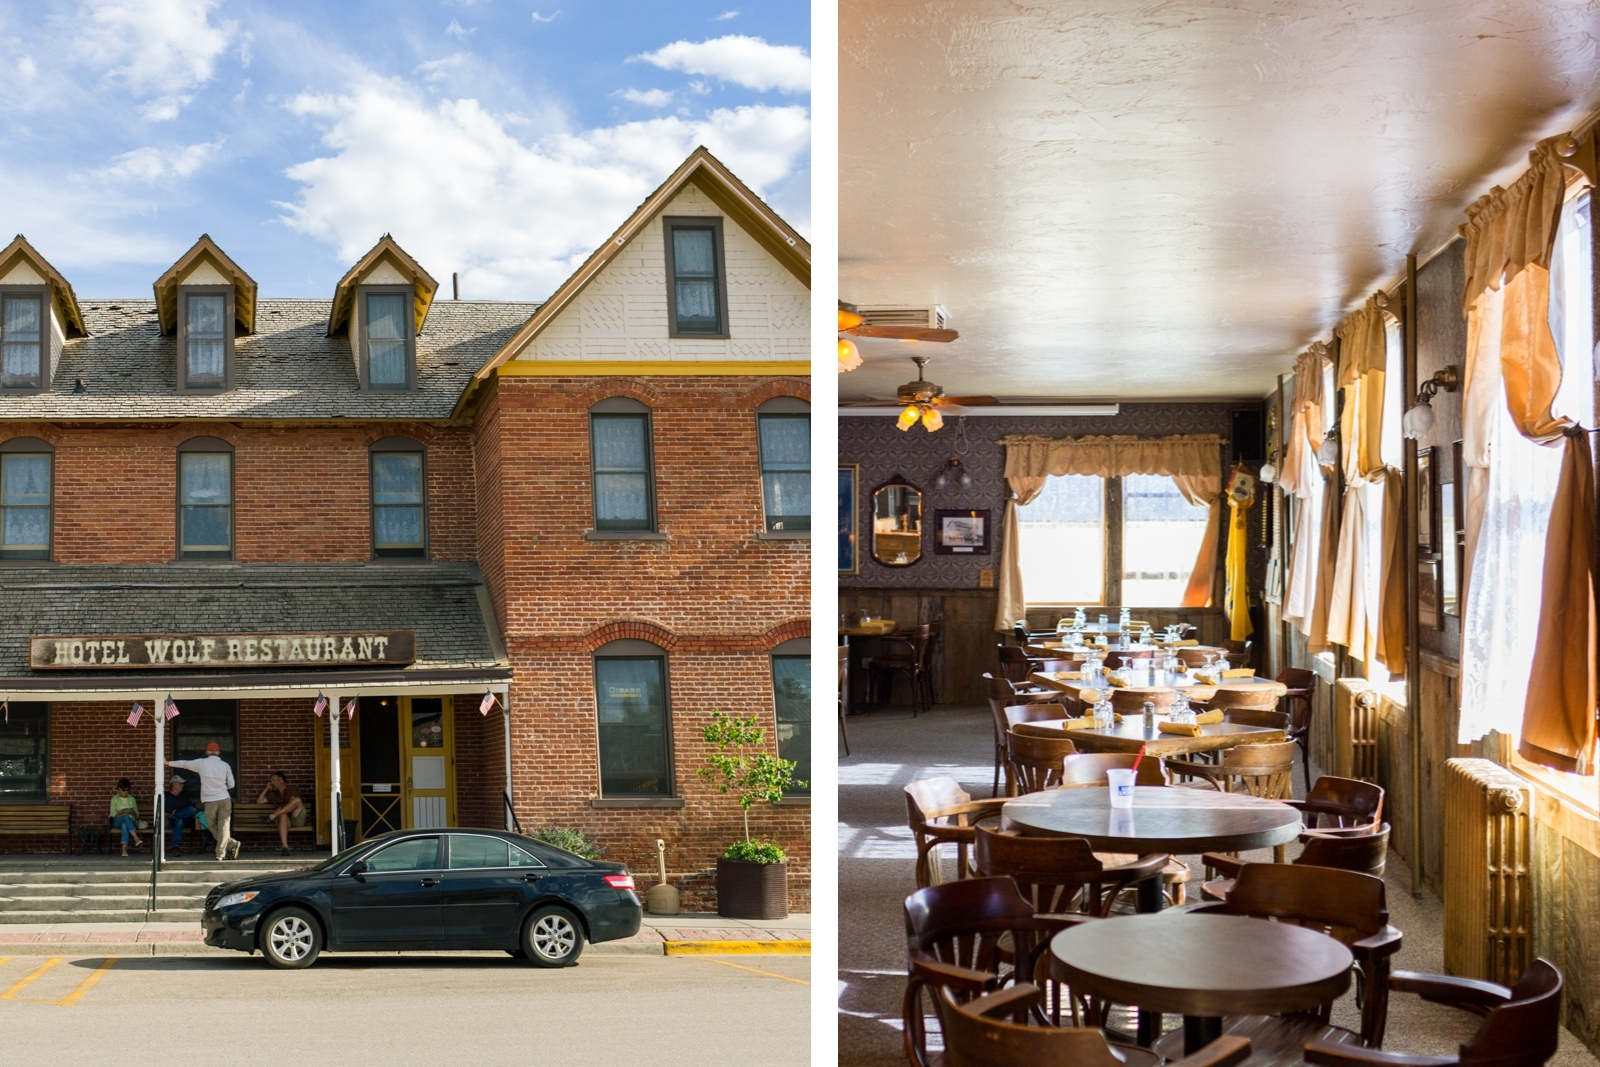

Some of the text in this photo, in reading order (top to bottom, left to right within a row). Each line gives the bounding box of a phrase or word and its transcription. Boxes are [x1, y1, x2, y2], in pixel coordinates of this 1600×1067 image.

[54, 636, 389, 664] HOTEL WOLF RESTAURANT
